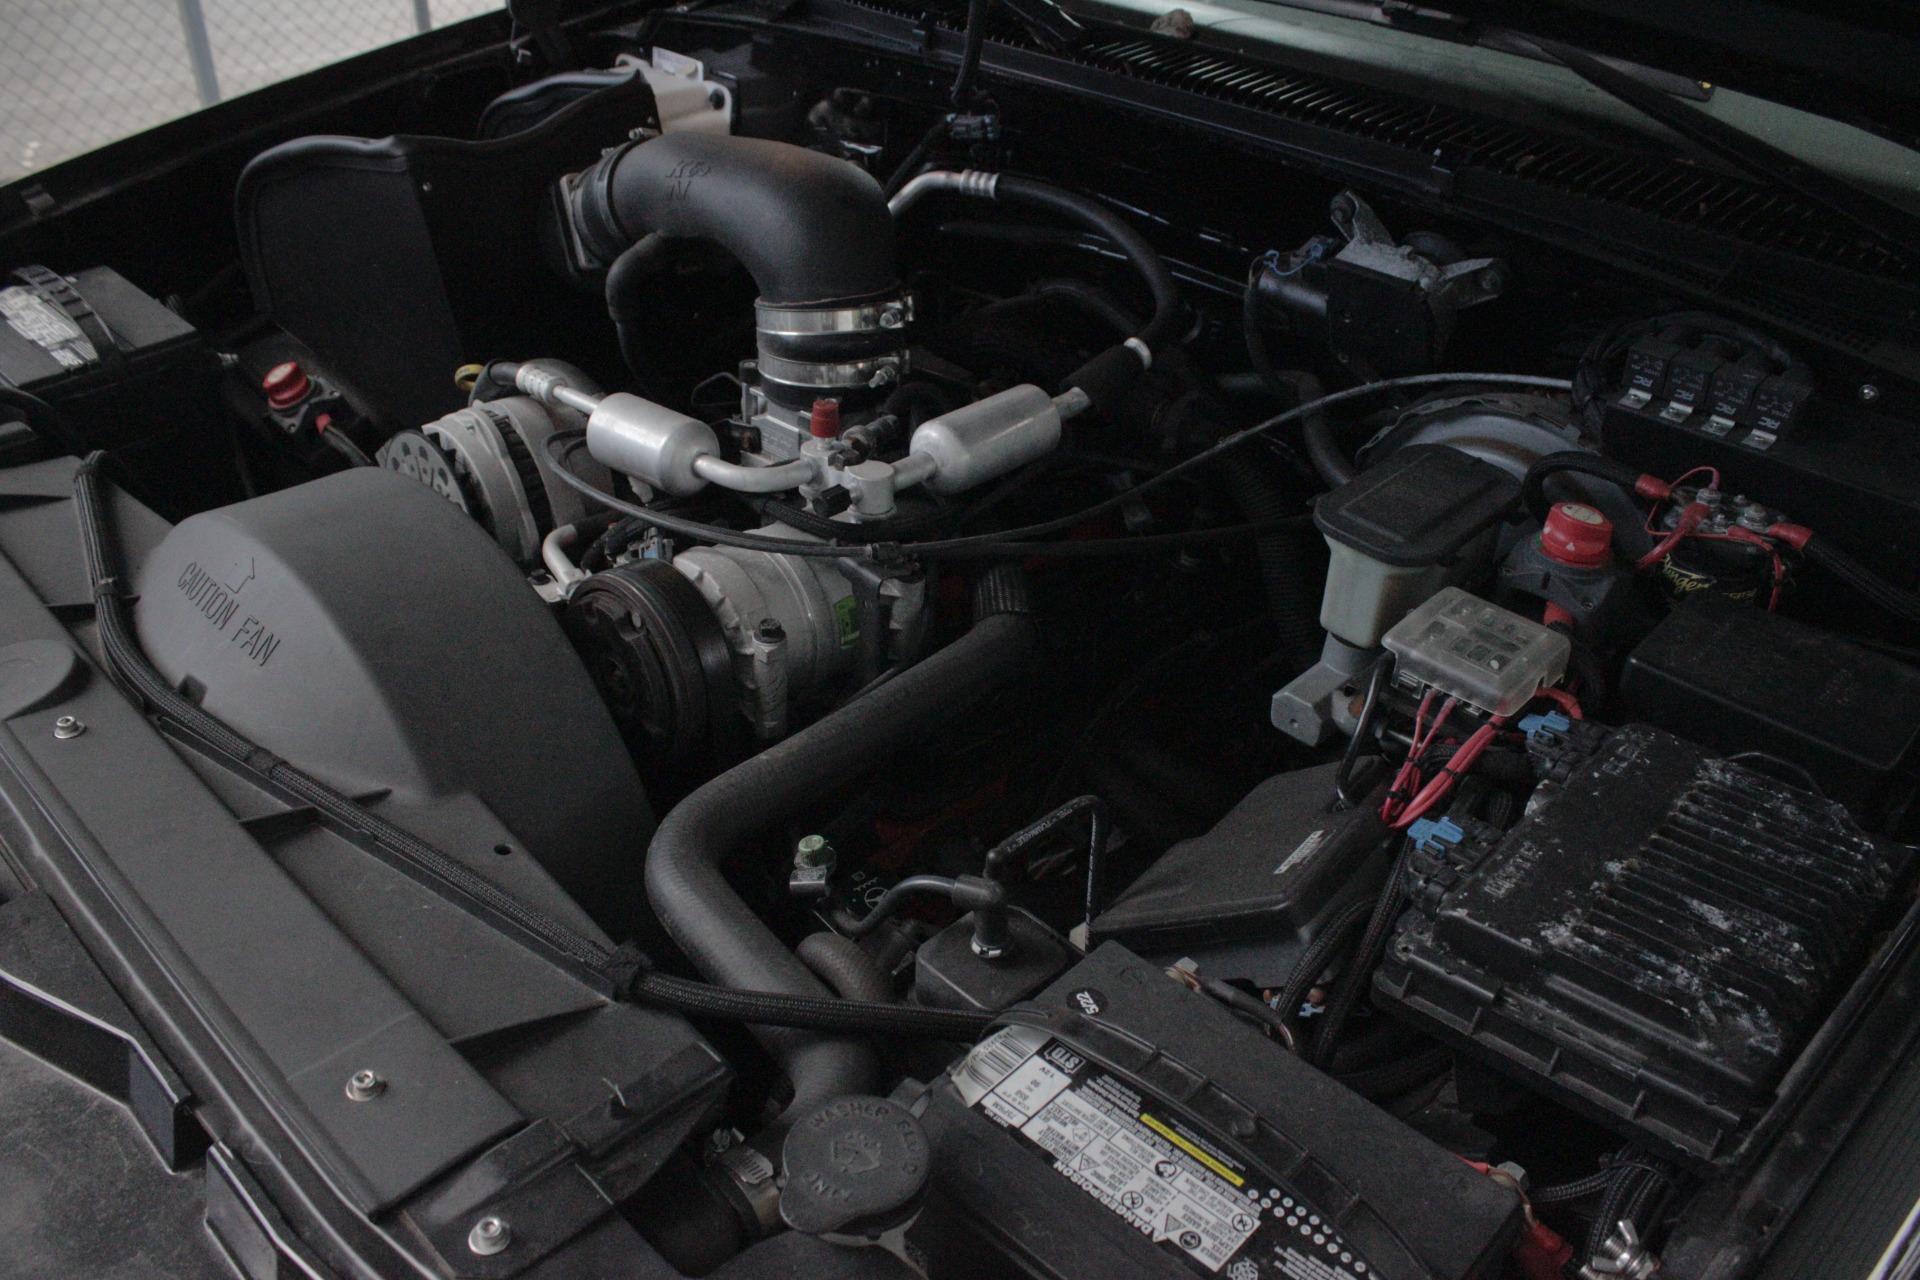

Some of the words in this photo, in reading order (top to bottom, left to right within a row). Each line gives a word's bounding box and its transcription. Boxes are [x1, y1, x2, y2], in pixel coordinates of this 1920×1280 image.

[176, 560, 240, 630] CAUTION
[231, 614, 281, 666] FAN
[1075, 990, 1099, 1015] 5/22
[1050, 1045, 1079, 1068] STD
[1037, 1128, 1075, 1156] IMMEDIATELY
[1052, 1159, 1153, 1235] DANGER/POISON
[1180, 1212, 1202, 1229] GASES
[1200, 1226, 1234, 1251] EXPLOSIVE
